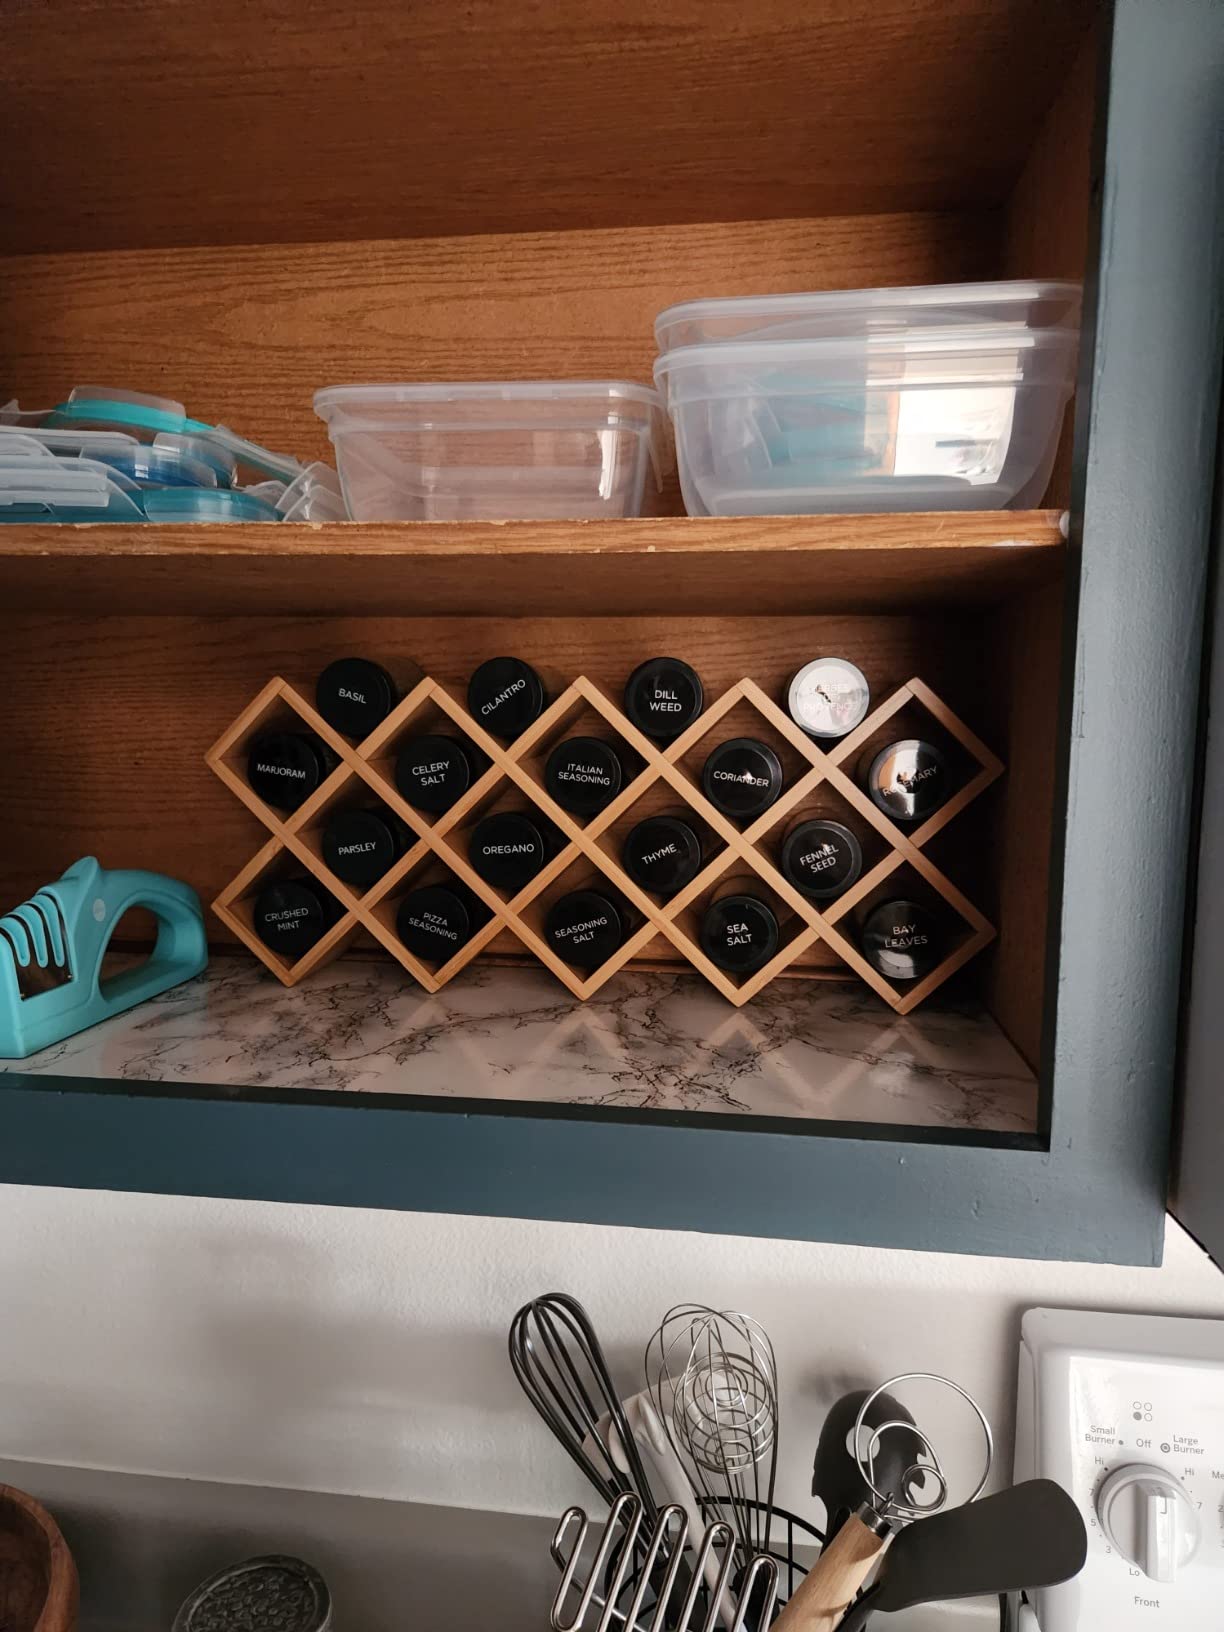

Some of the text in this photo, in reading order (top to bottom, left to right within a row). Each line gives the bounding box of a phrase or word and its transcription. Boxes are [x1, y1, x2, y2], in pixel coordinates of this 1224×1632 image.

[338, 688, 367, 704] BASIL
[481, 679, 526, 715] CILANTRO
[654, 689, 678, 700] DILL
[649, 701, 682, 712] WEED
[257, 763, 306, 779] MARJORAM
[412, 760, 450, 776] CELERY
[567, 763, 603, 775] ITALIAN
[421, 773, 446, 786] SALT
[558, 771, 611, 786] SEASONING
[713, 770, 769, 788] CORIANDER
[338, 842, 376, 856] PARSLEY
[482, 843, 535, 855] OREGANO
[641, 843, 678, 865] THYME
[799, 844, 839, 867] FENNEL
[810, 855, 837, 874] SEED
[265, 907, 309, 923] CRUSHED
[423, 912, 448, 927] PIZZA
[277, 920, 301, 932] MINT
[408, 917, 458, 940] SEASONING
[554, 916, 608, 938] SEASONING
[726, 923, 749, 934] SEA
[892, 924, 917, 935] BAY
[573, 931, 595, 944] SALT
[726, 933, 752, 946] SALT
[884, 935, 928, 948] LEAVES
[1090, 1425, 1115, 1435] Small
[1085, 1433, 1115, 1445] Burner
[1136, 1438, 1152, 1448] Off
[1173, 1435, 1198, 1446] Large
[1173, 1444, 1204, 1455] Burner
[1094, 1456, 1104, 1465] Hi
[1184, 1468, 1194, 1476] Hi
[1212, 1471, 1224, 1480] Me
[1090, 1519, 1096, 1527] 5
[1129, 1568, 1140, 1576] Lo
[1134, 1596, 1160, 1608] Front
